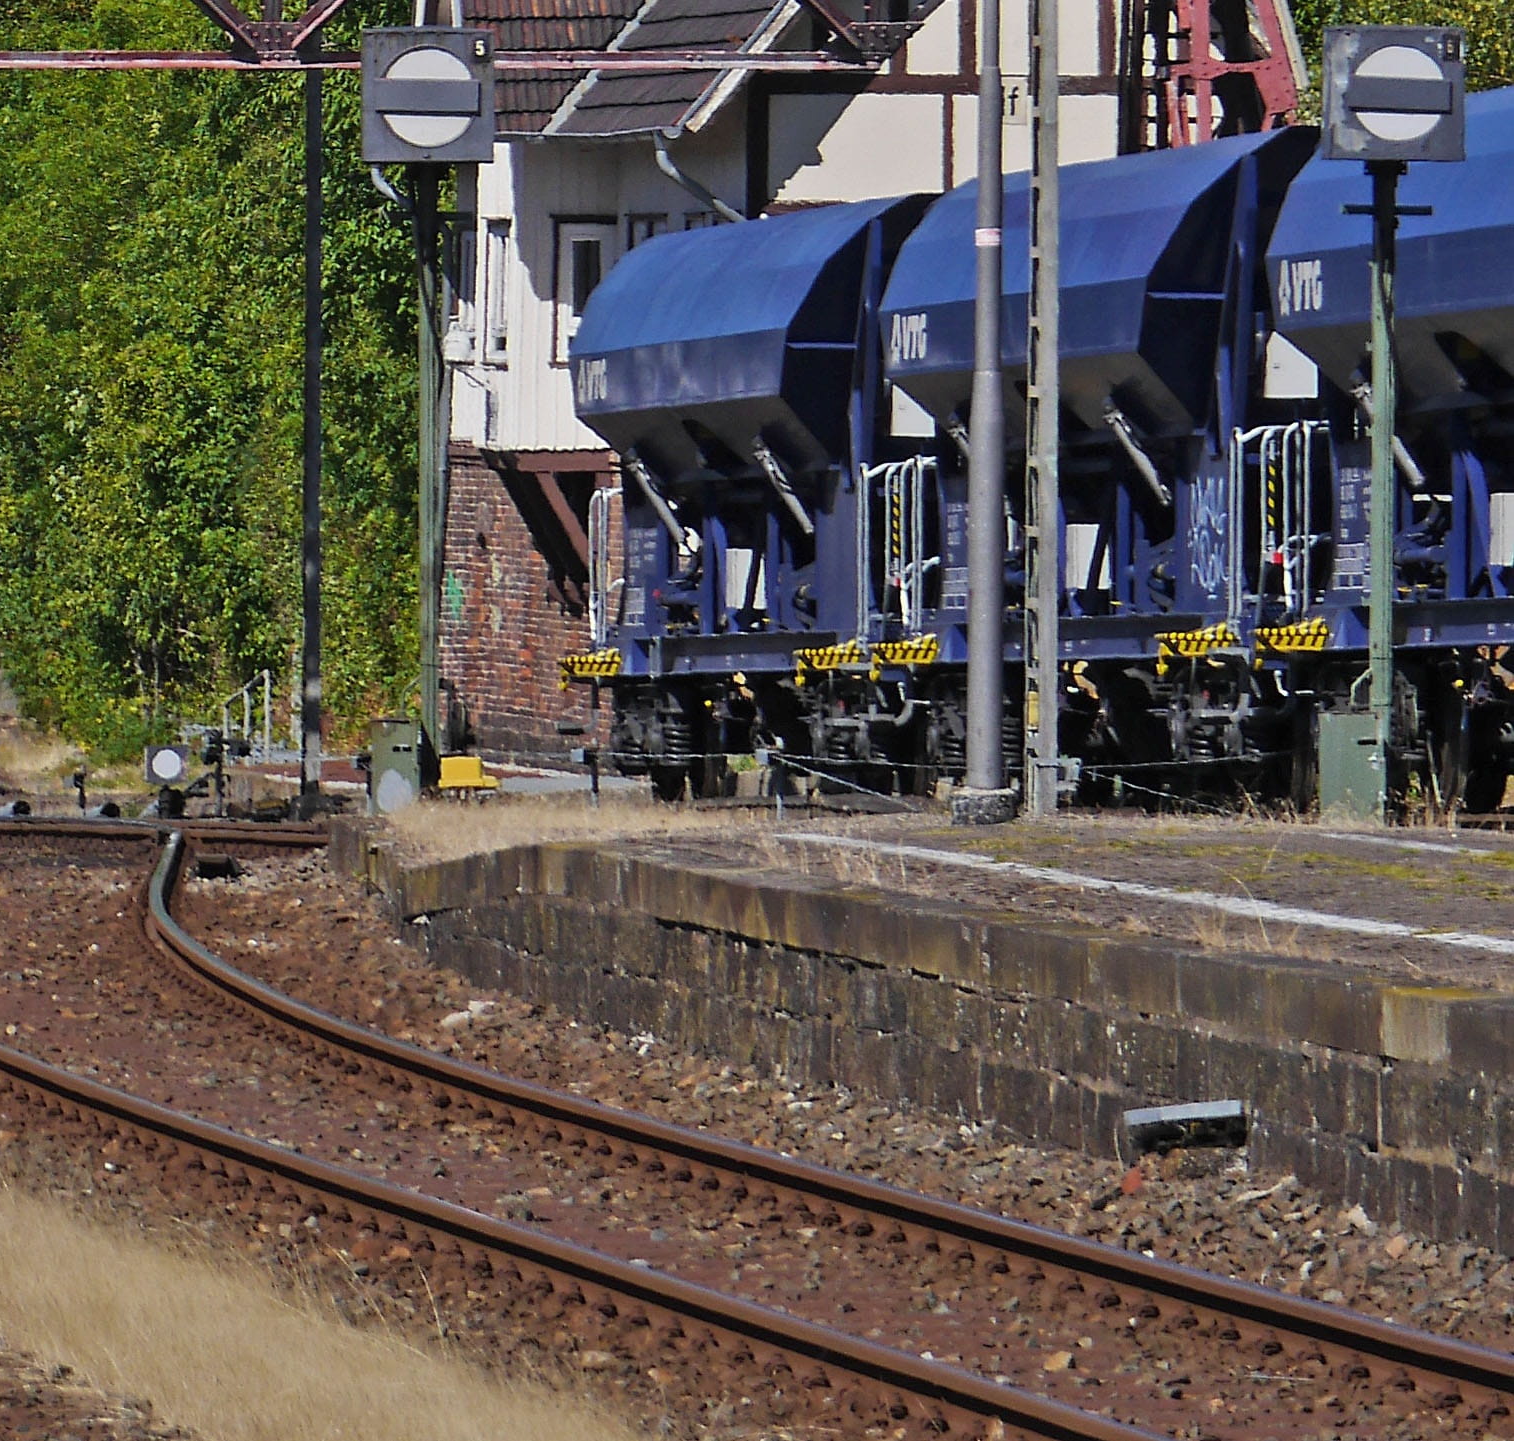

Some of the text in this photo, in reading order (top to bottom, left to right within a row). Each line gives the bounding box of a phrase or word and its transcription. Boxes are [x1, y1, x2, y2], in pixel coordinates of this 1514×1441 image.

[475, 39, 485, 56] 5
[1291, 259, 1323, 311] VTG
[901, 312, 927, 360] VTG
[586, 358, 608, 401] VTG
